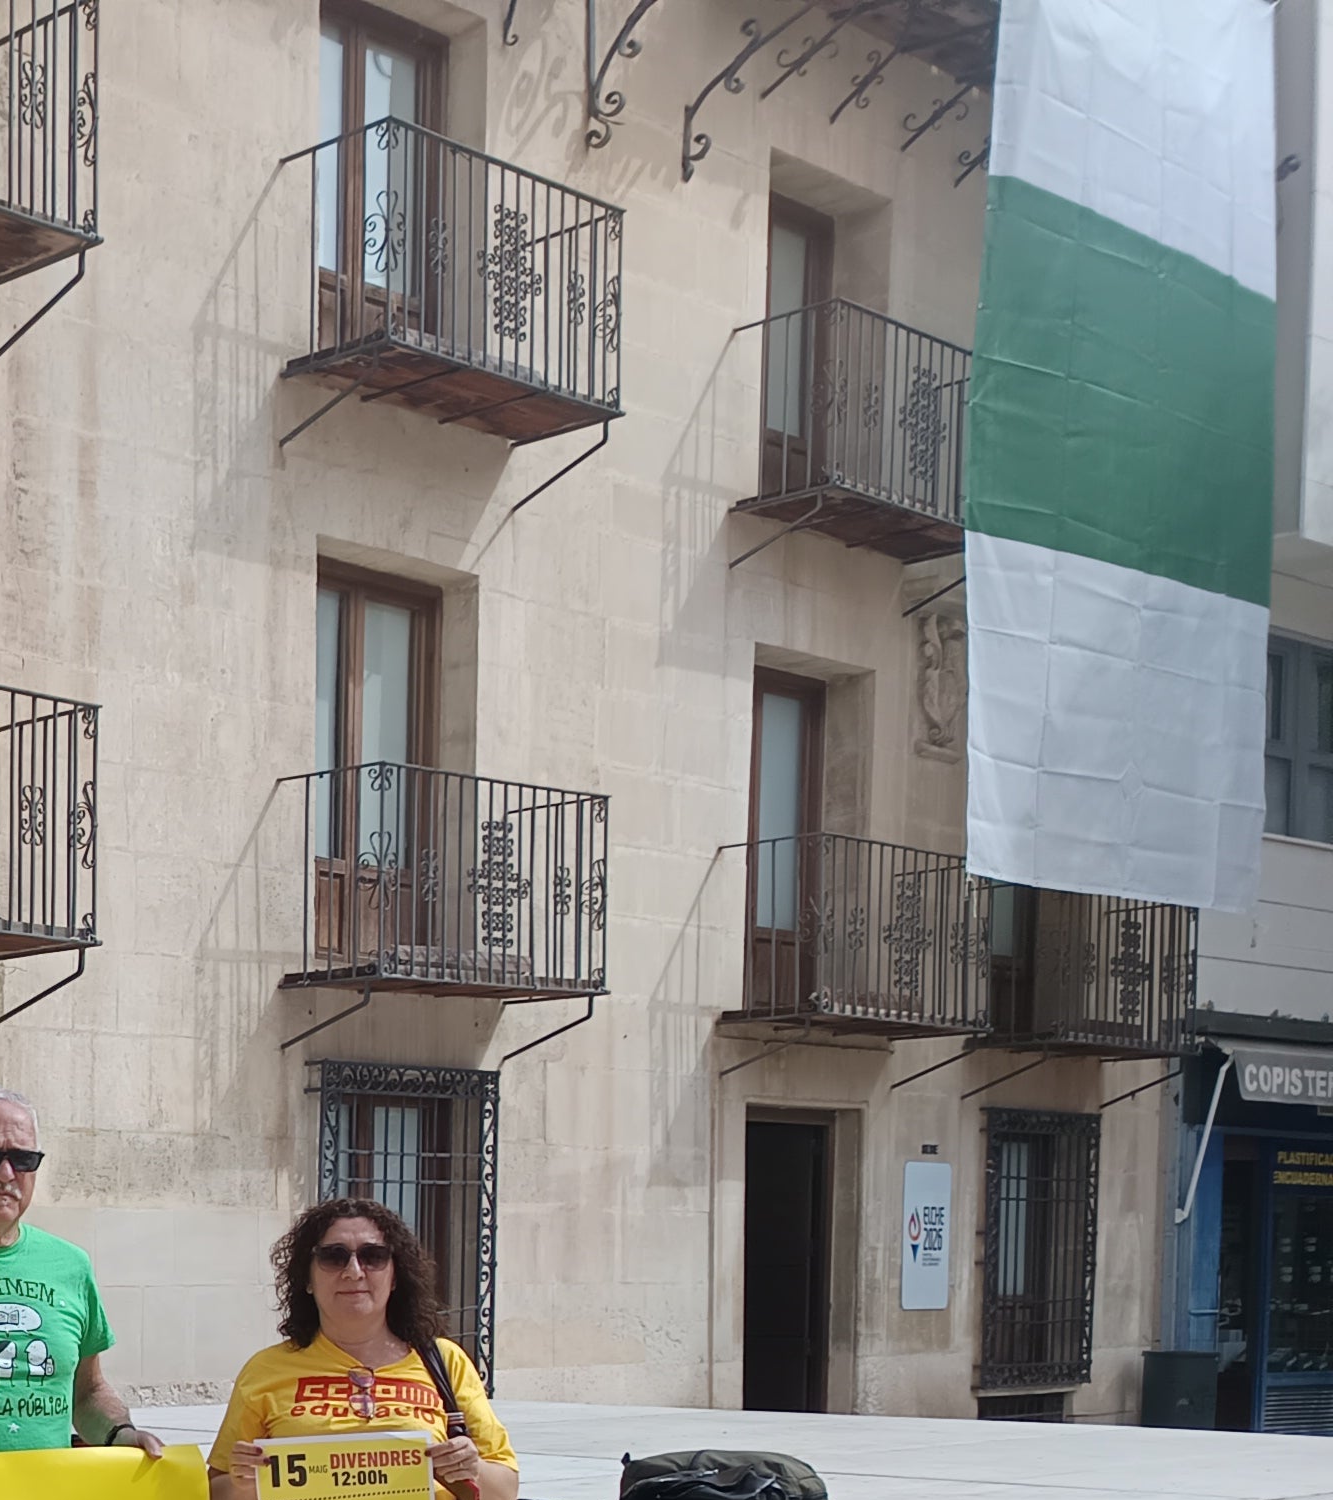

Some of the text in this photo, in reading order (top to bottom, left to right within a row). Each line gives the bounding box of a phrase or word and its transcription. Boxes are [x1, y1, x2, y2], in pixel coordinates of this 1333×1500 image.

[923, 1228, 943, 1251] 2026
[18, 1393, 69, 1418] PÚBLICA
[269, 1450, 422, 1488] 15 MAIG DIVENDRES
[332, 1470, 388, 1486] 12:00h
